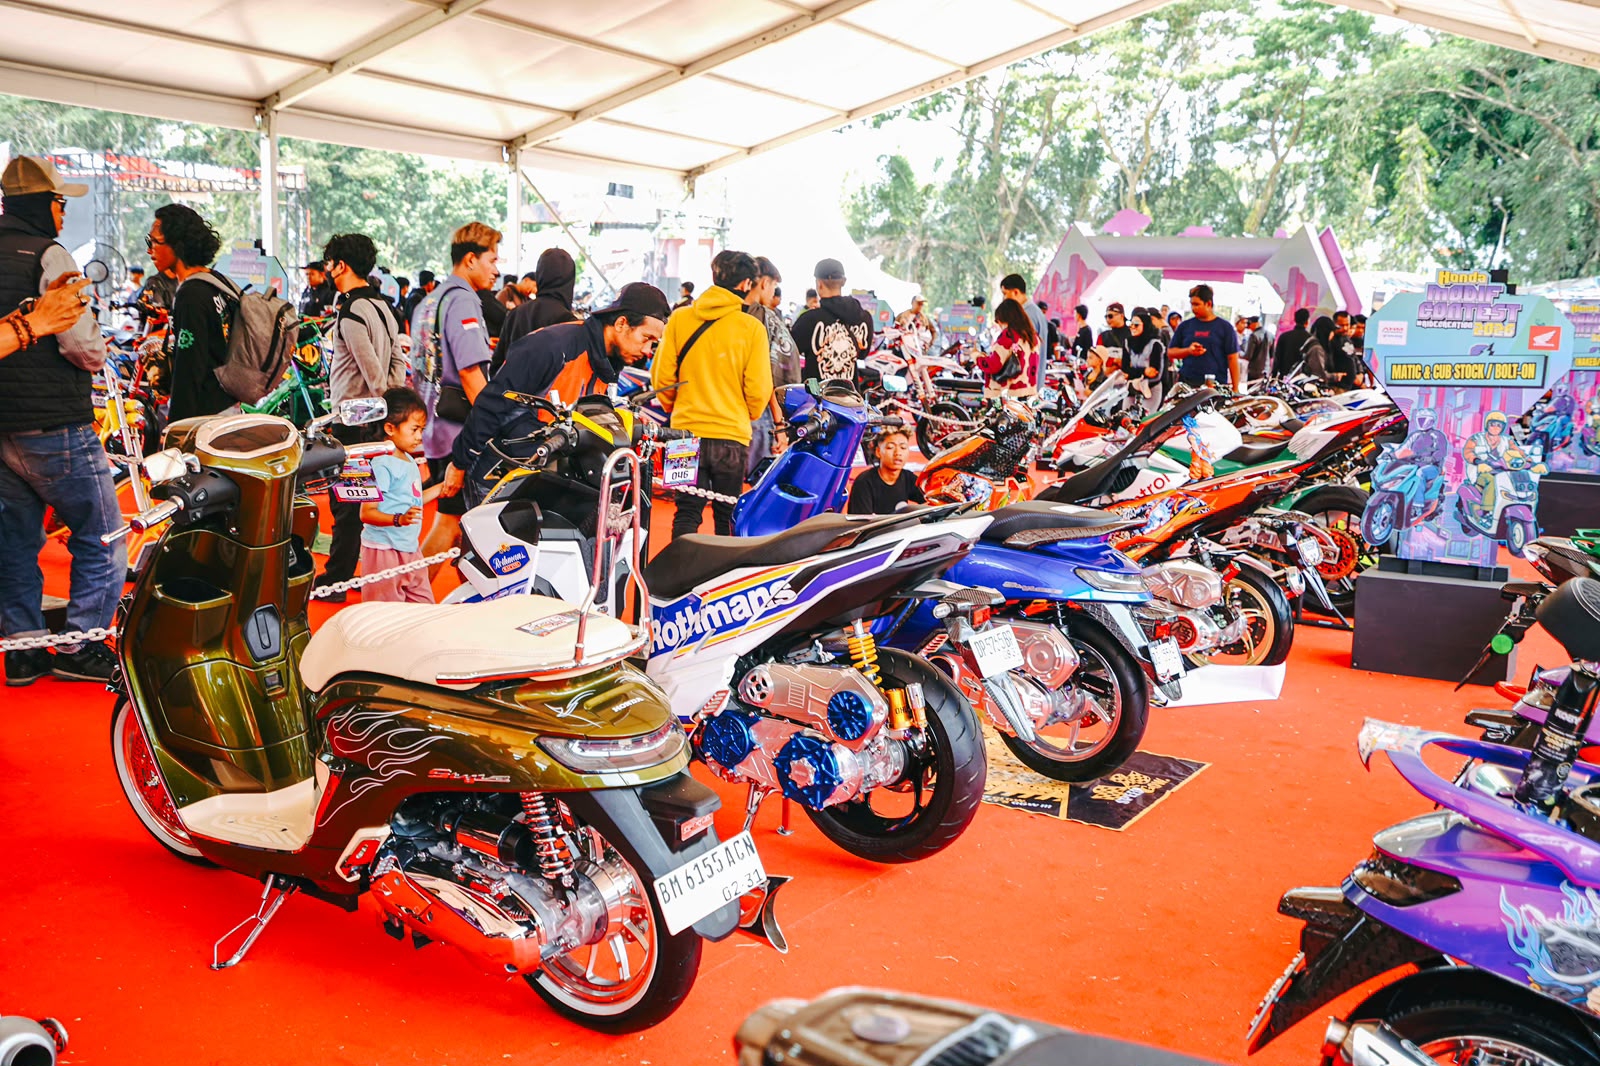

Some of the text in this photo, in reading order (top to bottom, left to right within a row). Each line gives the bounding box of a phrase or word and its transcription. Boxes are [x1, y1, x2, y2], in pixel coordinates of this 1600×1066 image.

[1438, 271, 1487, 285] Honda
[1427, 284, 1504, 302] MODIF
[1418, 301, 1523, 322] CONTEST
[1473, 322, 1516, 337] 2026
[1391, 363, 1536, 380] MATIC & CUB STOCK / BOLT-ON
[671, 470, 689, 481] 046
[346, 489, 369, 497] 019
[1134, 473, 1171, 500] trol
[650, 579, 797, 653] Rothmans
[611, 696, 645, 713] HONDA
[658, 874, 683, 905] BM
[685, 851, 724, 890] 6155
